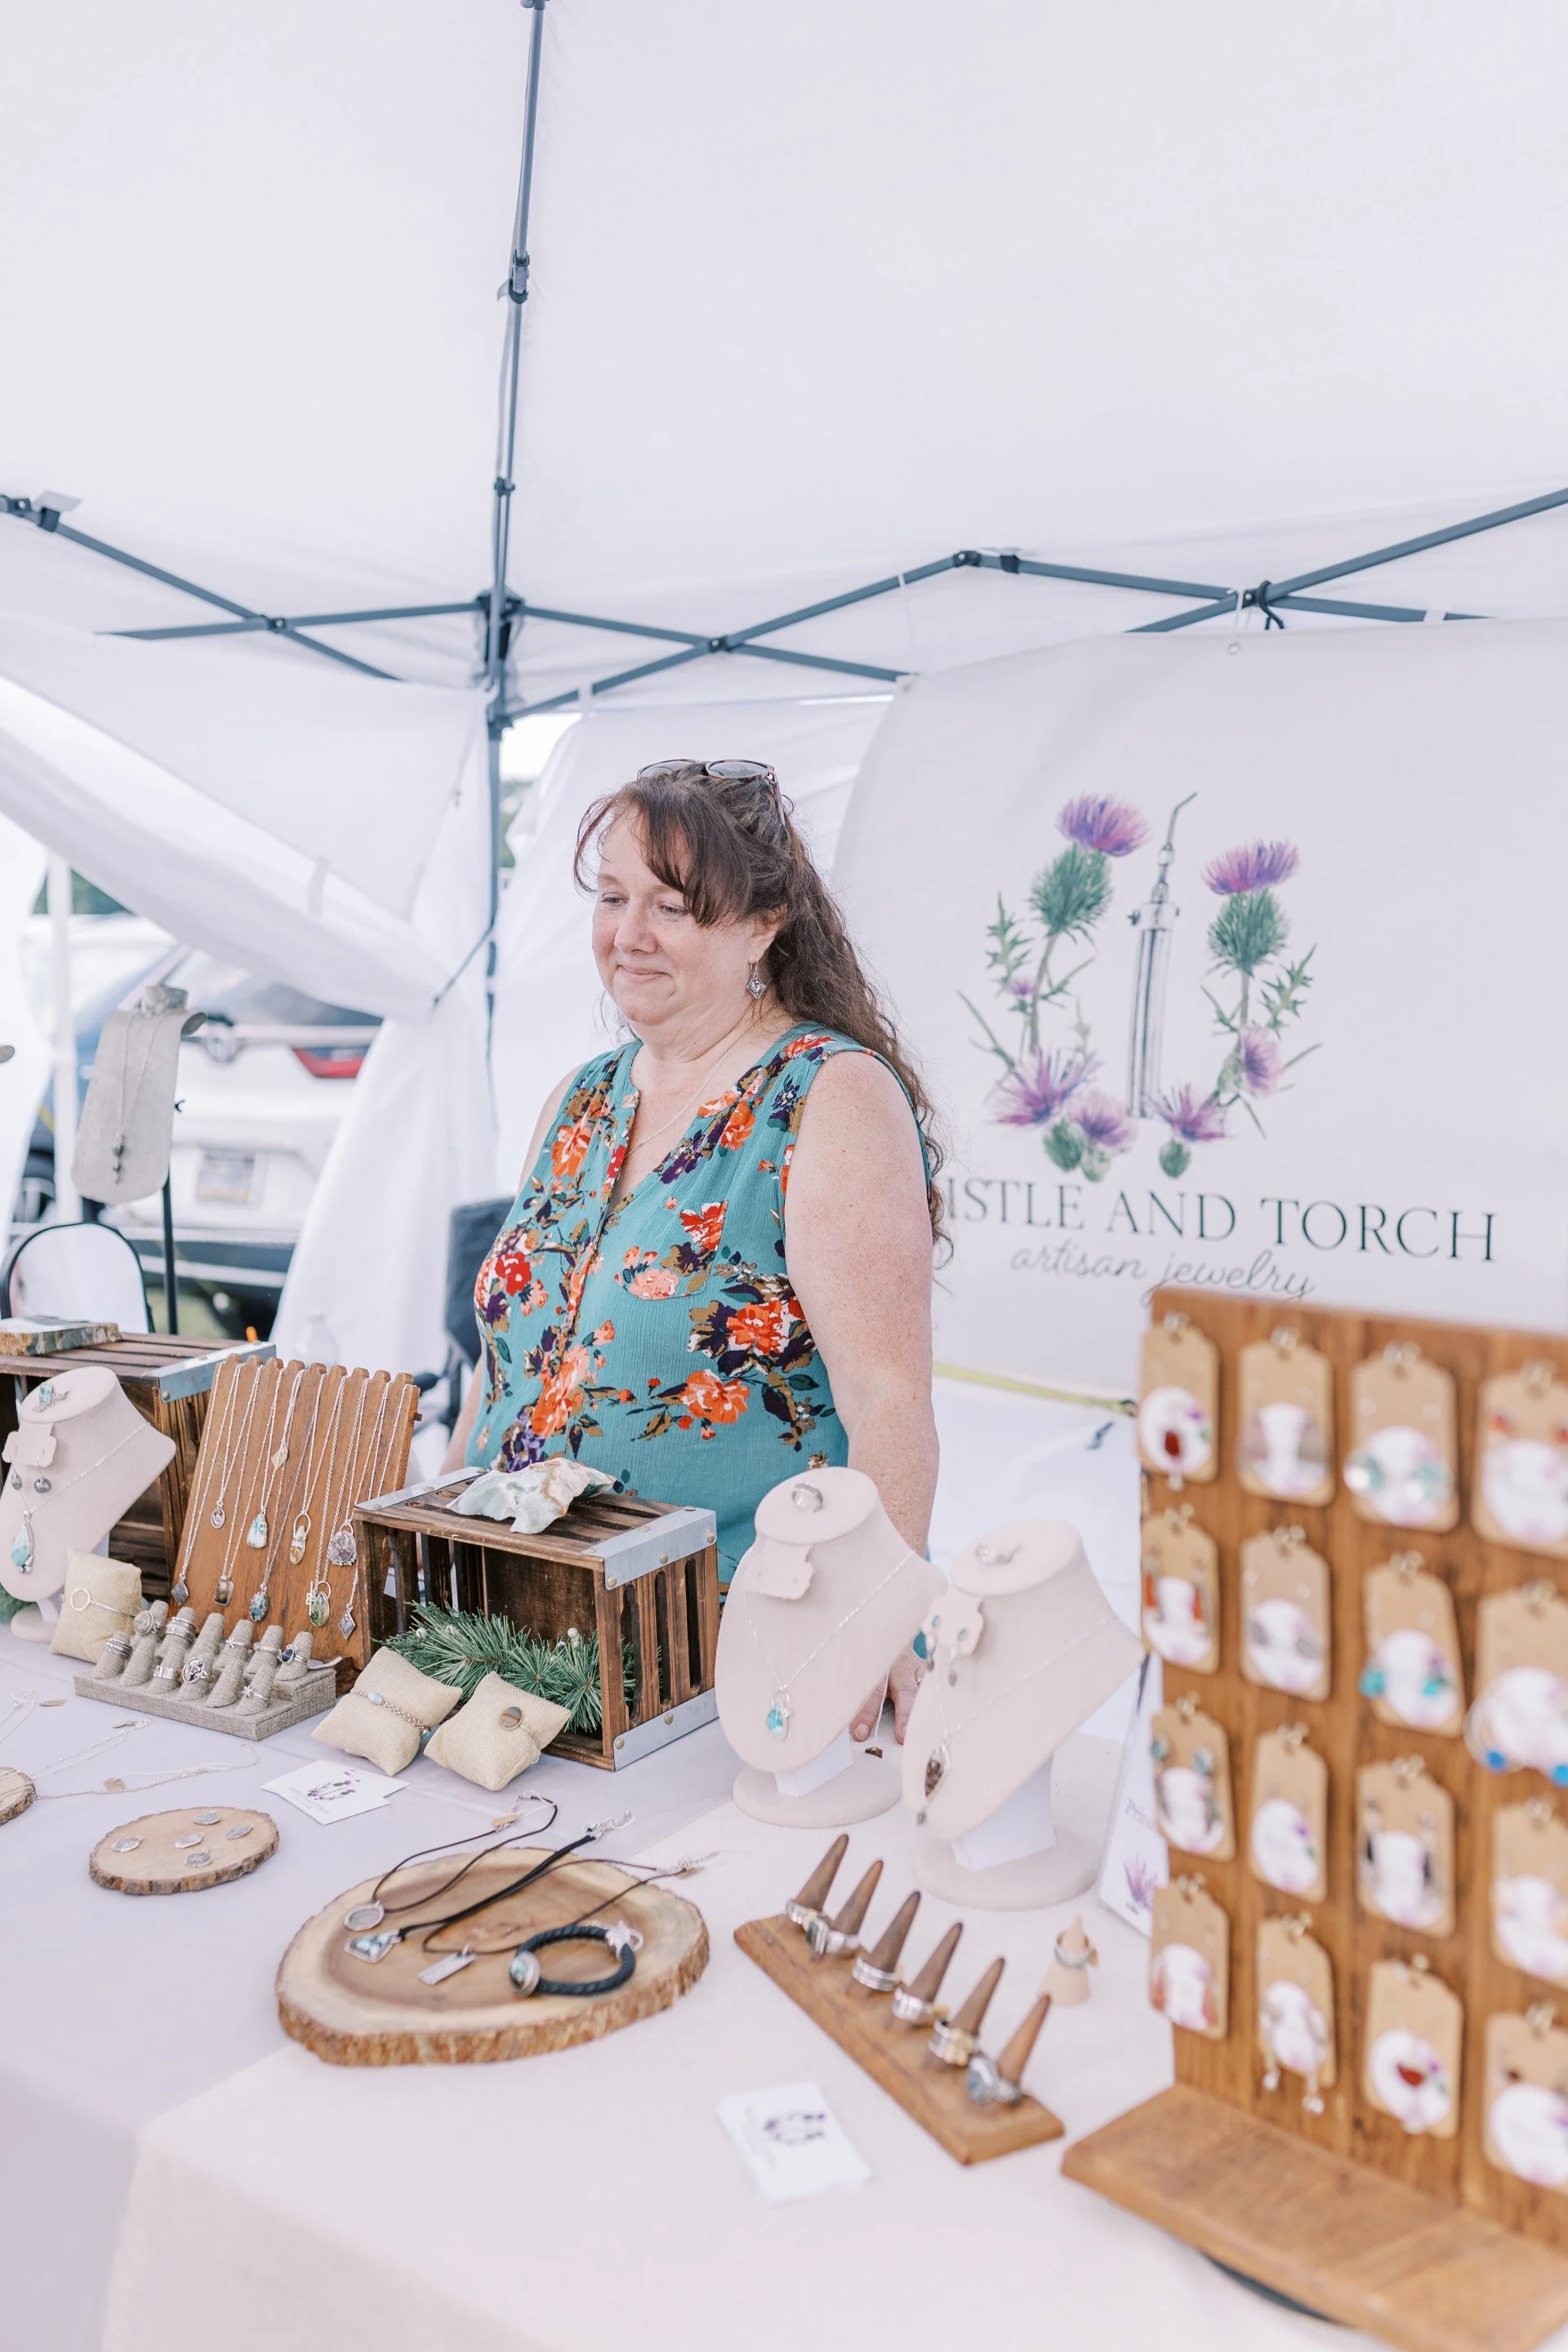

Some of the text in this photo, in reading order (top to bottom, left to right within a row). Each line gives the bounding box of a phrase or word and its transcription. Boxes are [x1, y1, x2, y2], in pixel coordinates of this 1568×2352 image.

[947, 1175, 1497, 1263] ISTLE AND TORCH
[1009, 1238, 1316, 1308] artisan jewelry
